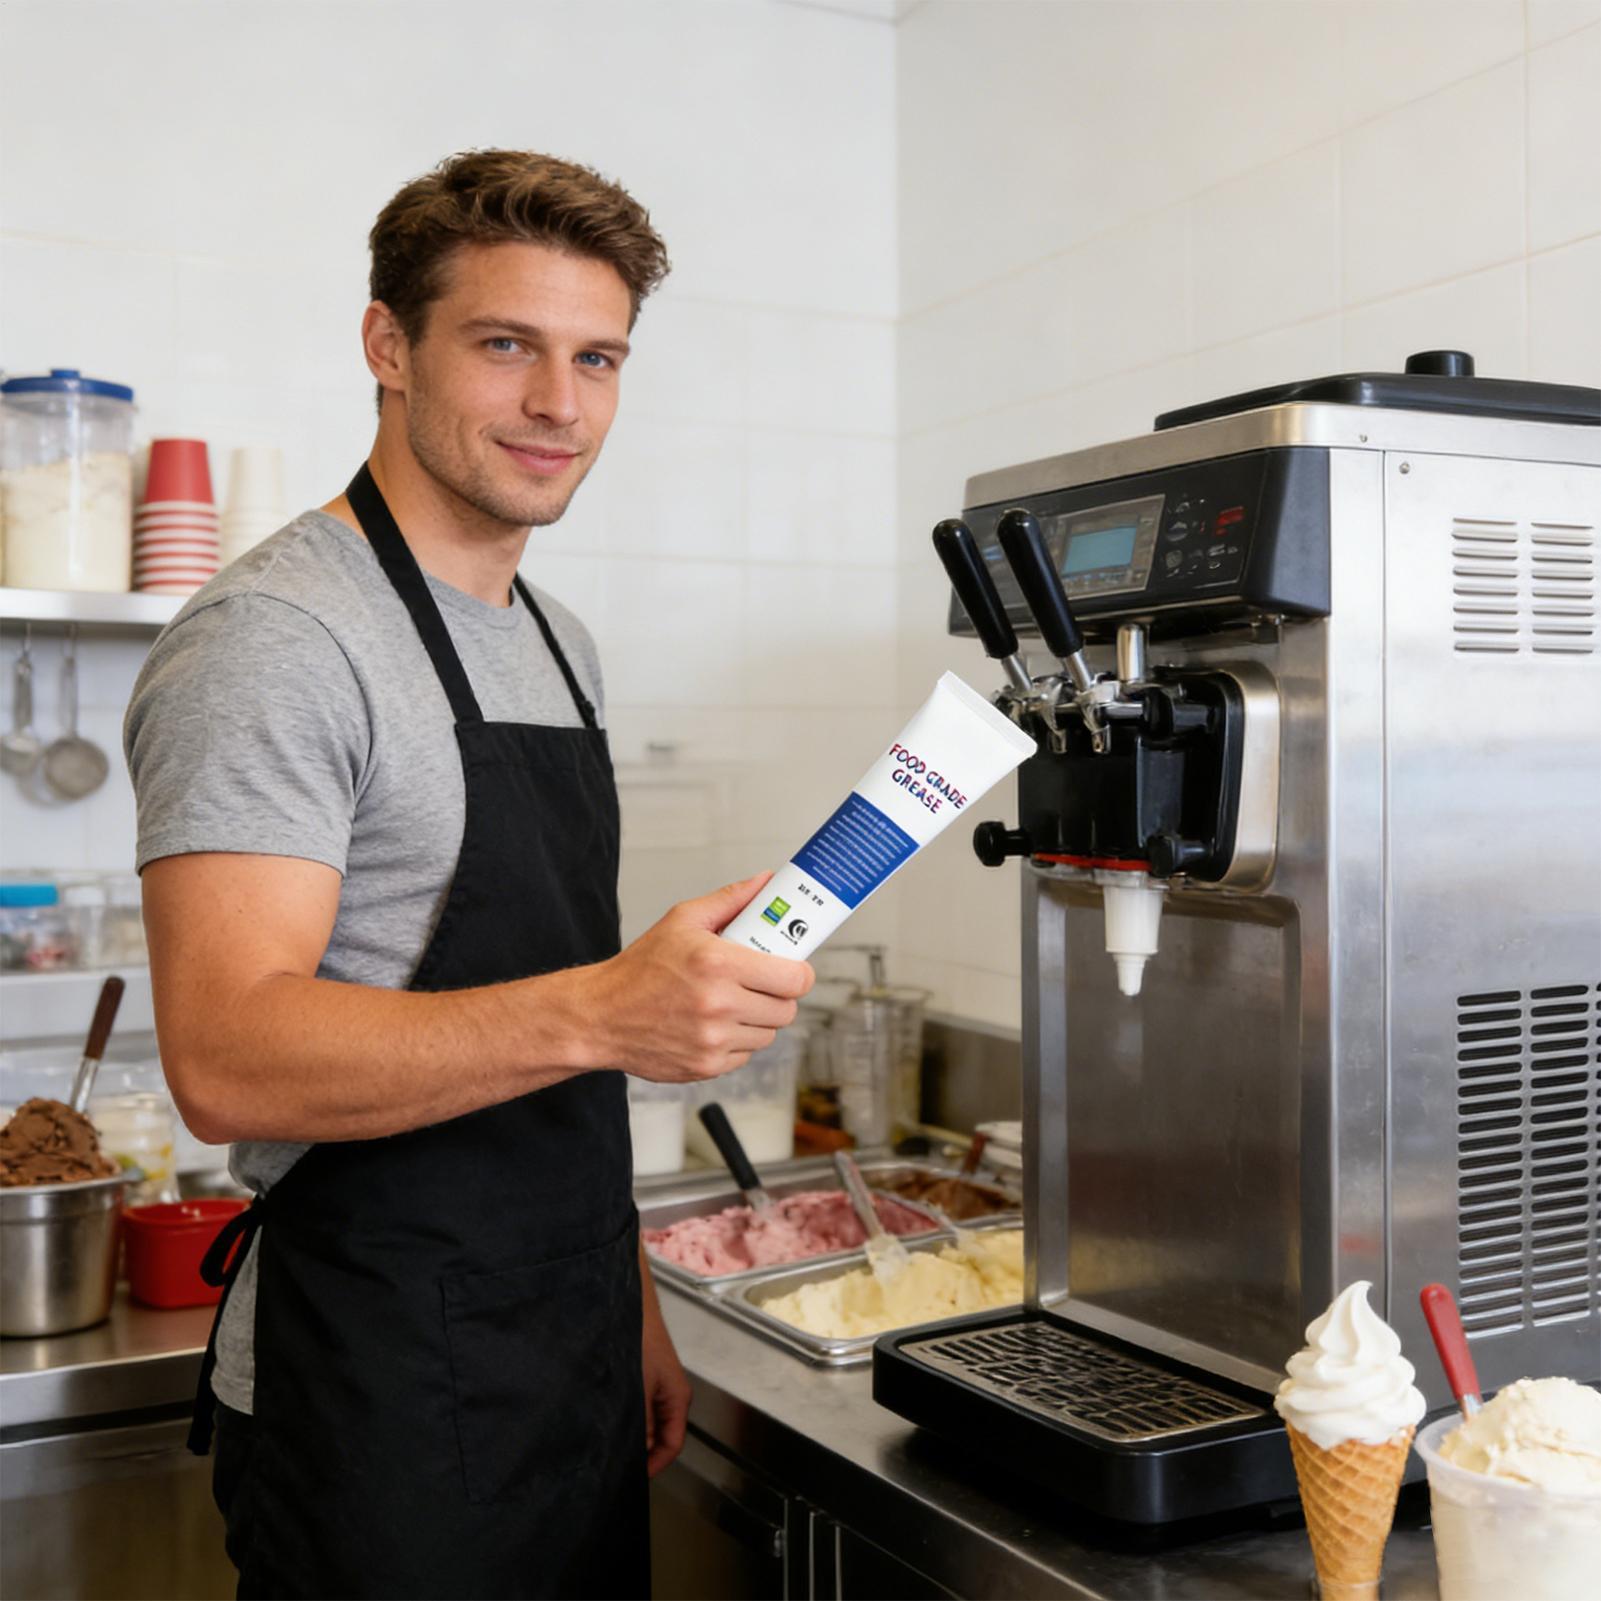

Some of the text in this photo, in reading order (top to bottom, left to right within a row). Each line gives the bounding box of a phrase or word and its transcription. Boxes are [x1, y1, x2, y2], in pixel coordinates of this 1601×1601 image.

[889, 744, 968, 809] FOOD GRADE
[892, 769, 943, 814] GREASE
